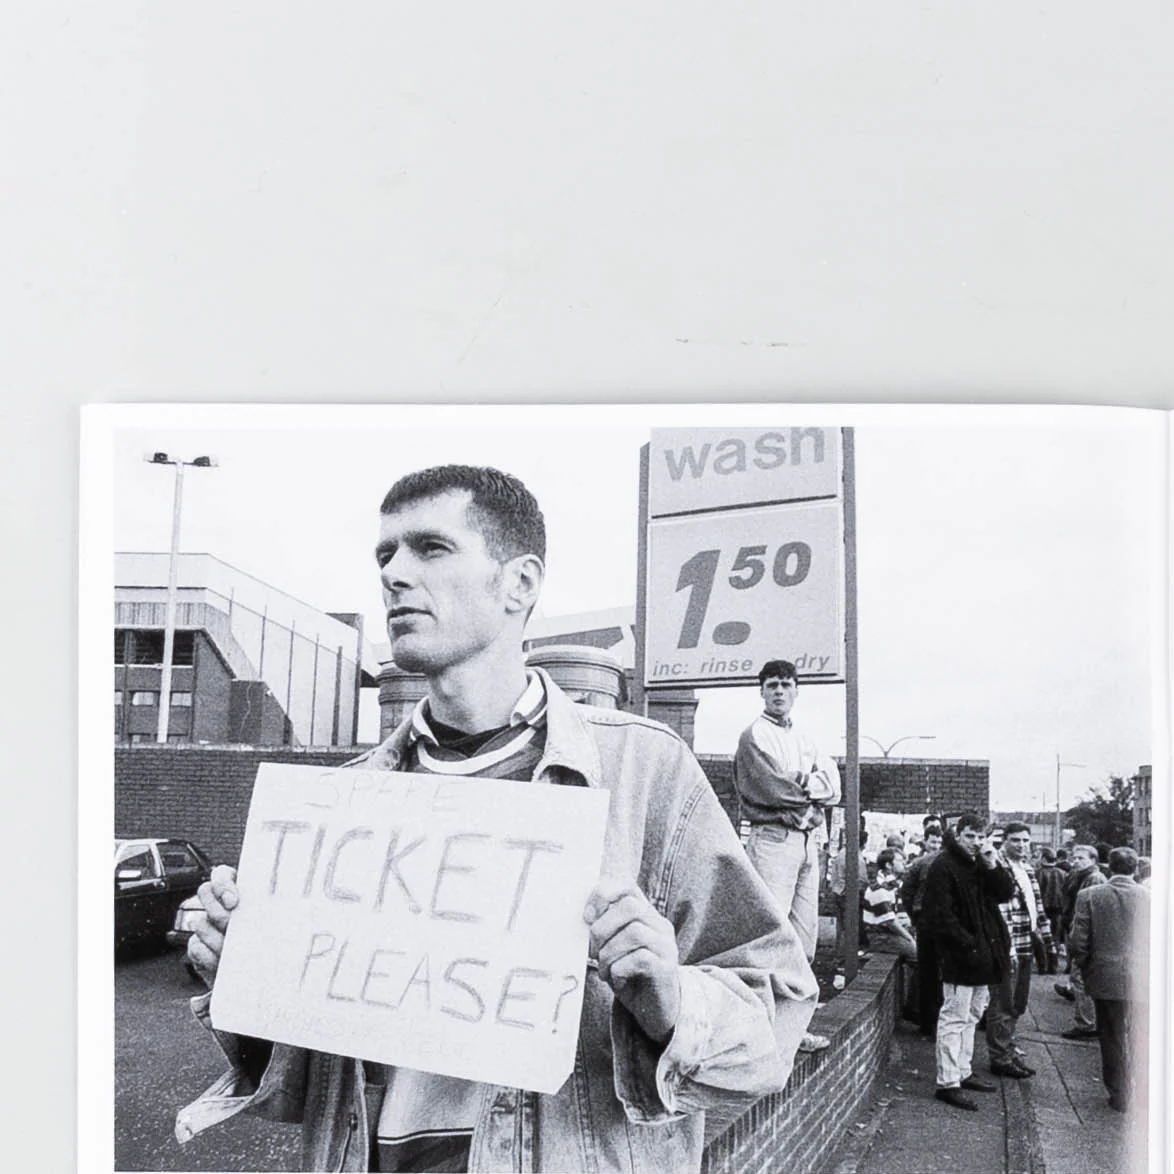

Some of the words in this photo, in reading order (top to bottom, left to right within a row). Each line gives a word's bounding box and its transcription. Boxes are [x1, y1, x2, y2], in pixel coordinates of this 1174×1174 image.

[664, 427, 825, 482] wash
[652, 660, 689, 677] inc:
[700, 656, 753, 674] rinse
[794, 652, 830, 672] dry
[261, 820, 565, 932] TICKET
[299, 932, 579, 1035] PLEASE?
